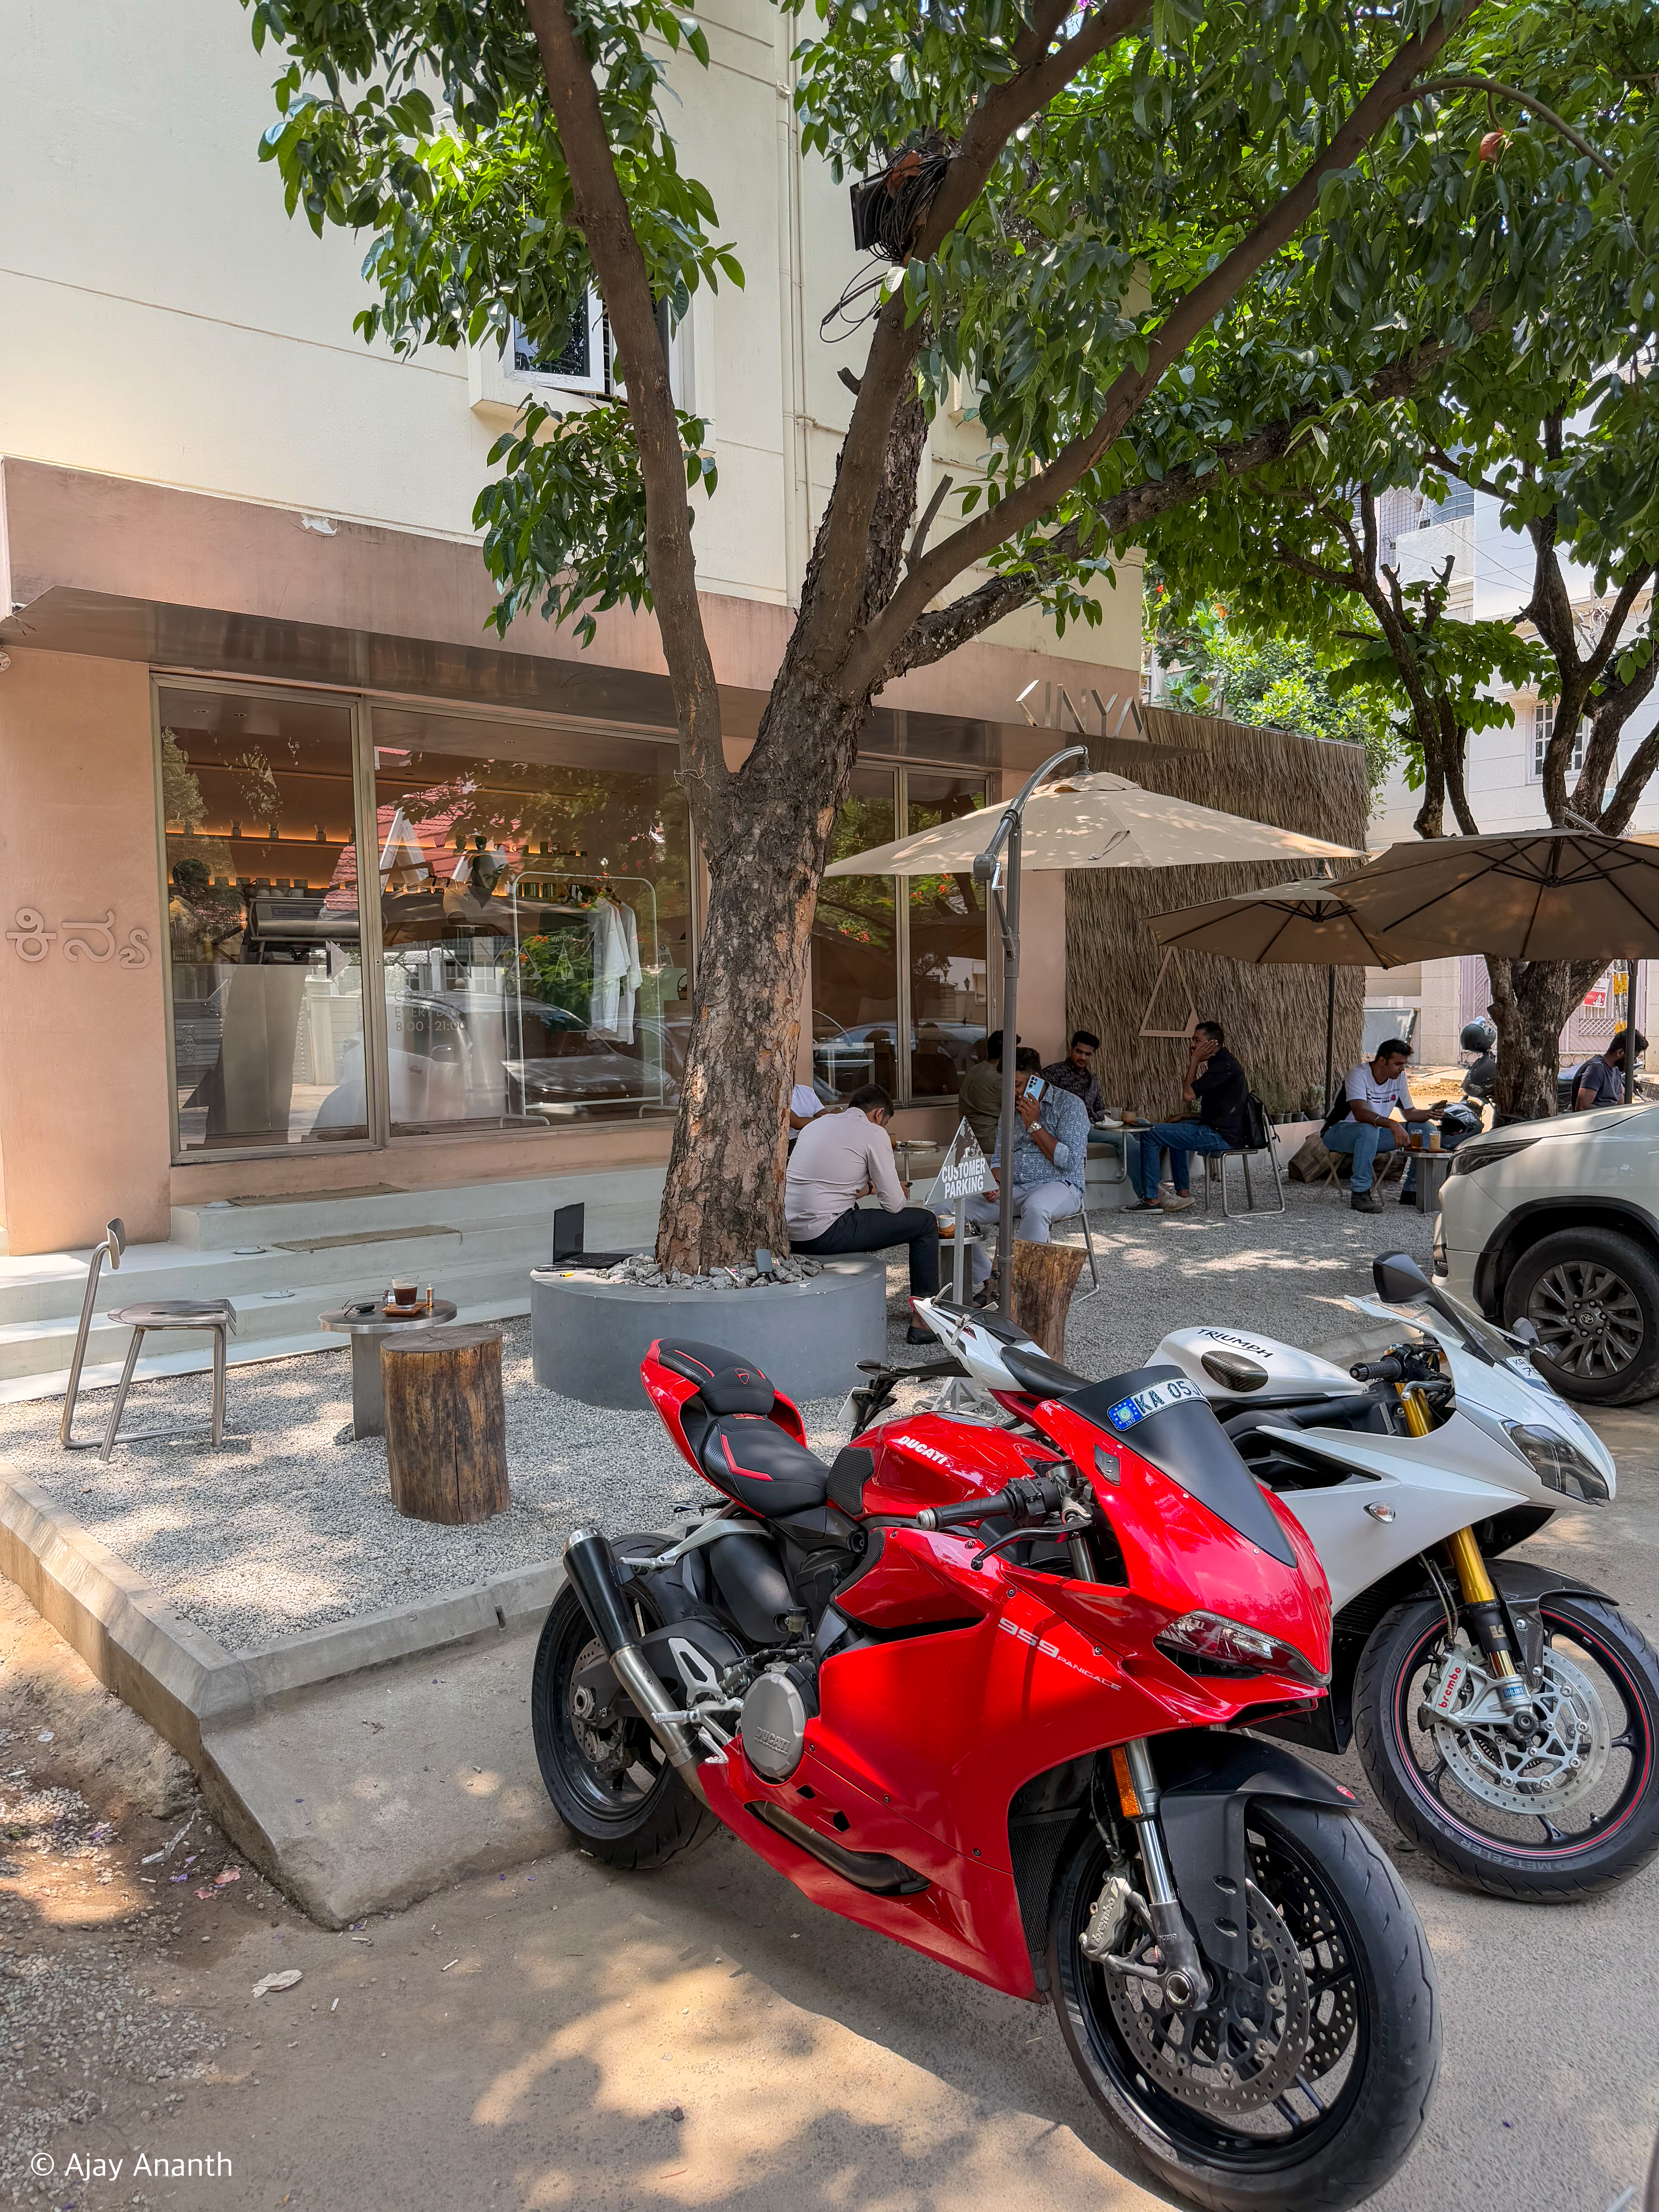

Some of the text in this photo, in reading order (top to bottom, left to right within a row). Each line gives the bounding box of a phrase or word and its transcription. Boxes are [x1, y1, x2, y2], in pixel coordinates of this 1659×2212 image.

[1015, 679, 1149, 741] KINYA
[396, 1021, 424, 1032] 800
[435, 1020, 466, 1031] 21:00
[942, 1158, 986, 1183] CUSTOMER
[944, 1175, 983, 1199] PARKING
[1197, 1329, 1274, 1356] TRIUMPH
[1134, 1390, 1164, 1413] KA
[898, 1436, 949, 1465] DUCATI
[998, 1618, 1121, 1691] 959 PANIGALE
[1437, 1667, 1461, 1708] brembo
[1505, 1687, 1524, 1696] ÖHLINS
[755, 1726, 790, 1752] DUCATI
[1460, 1837, 1552, 1870] METZELER
[1092, 1898, 1115, 1945] brembo
